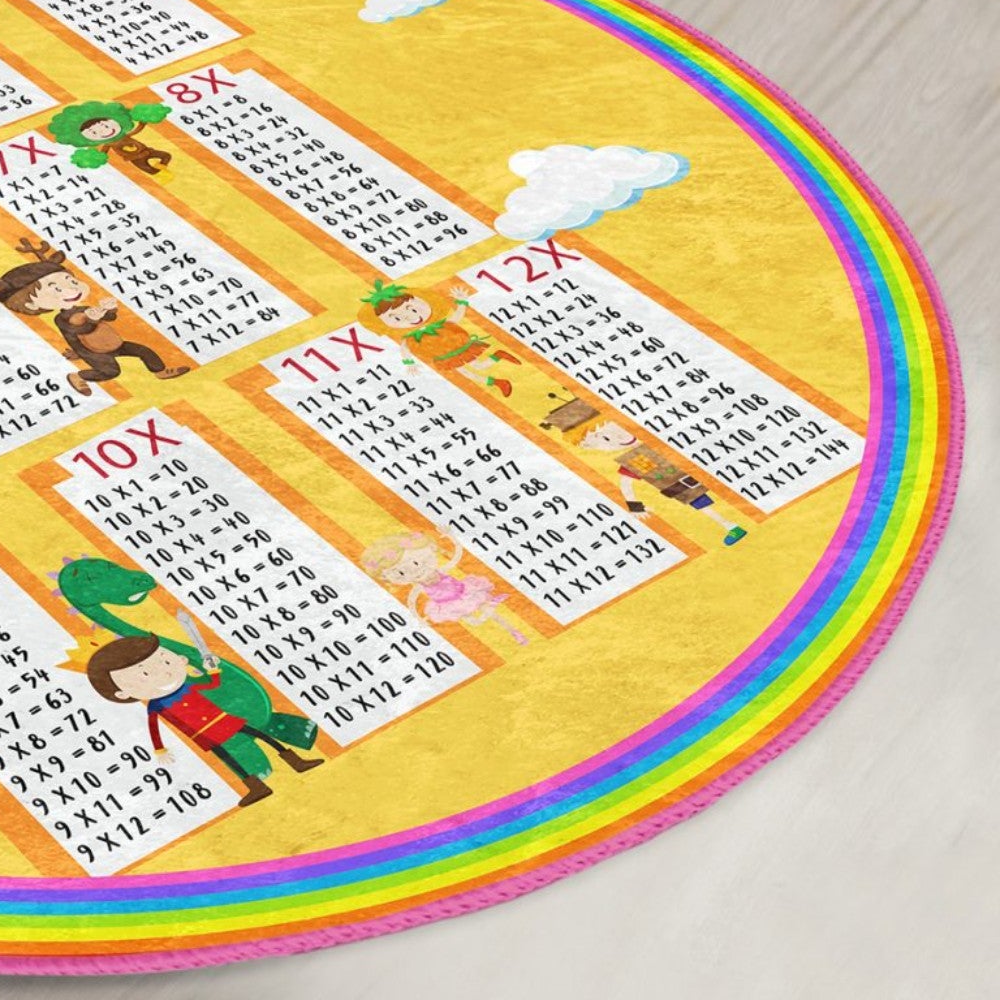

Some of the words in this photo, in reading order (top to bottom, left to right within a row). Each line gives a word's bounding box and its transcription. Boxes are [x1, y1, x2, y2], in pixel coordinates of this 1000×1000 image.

[47, 2, 60, 11] 4
[108, 45, 122, 54] 4
[135, 32, 157, 45] 11
[168, 20, 190, 32] 44
[9, 94, 33, 109] 36
[303, 201, 319, 213] 8
[330, 190, 347, 202] 8
[358, 176, 380, 190] 64
[58, 239, 72, 252] 7
[87, 227, 102, 240] 5
[117, 212, 140, 228] 35
[359, 241, 377, 254] 8
[387, 226, 411, 242] 11
[423, 210, 449, 226] 88
[148, 309, 162, 324] 7
[178, 293, 204, 310] 10
[217, 276, 243, 294] 70
[16, 363, 41, 381] 60
[575, 366, 604, 385] 12
[610, 353, 627, 367] 5
[640, 336, 665, 354] 60
[666, 430, 697, 450] 12
[703, 417, 721, 431] 9
[731, 393, 769, 416] 108
[425, 495, 453, 515] 11
[465, 479, 482, 496] 7
[495, 459, 522, 481] 77
[740, 481, 771, 501] 12
[777, 461, 807, 480] 12
[813, 438, 850, 461] 144
[187, 585, 217, 606] 10
[233, 567, 251, 584] 6
[267, 546, 294, 567] 60
[542, 587, 572, 608] 11
[584, 564, 616, 586] 12
[624, 537, 666, 564] 132
[276, 663, 307, 686] 10
[321, 639, 352, 662] 10
[366, 611, 407, 638] 100
[323, 705, 354, 728] 10
[368, 680, 402, 703] 12
[413, 650, 455, 679] 120
[27, 733, 47, 750] 8
[62, 707, 97, 732] 72
[76, 844, 95, 863] 9
[115, 815, 150, 841] 12
[165, 782, 212, 814] 108
